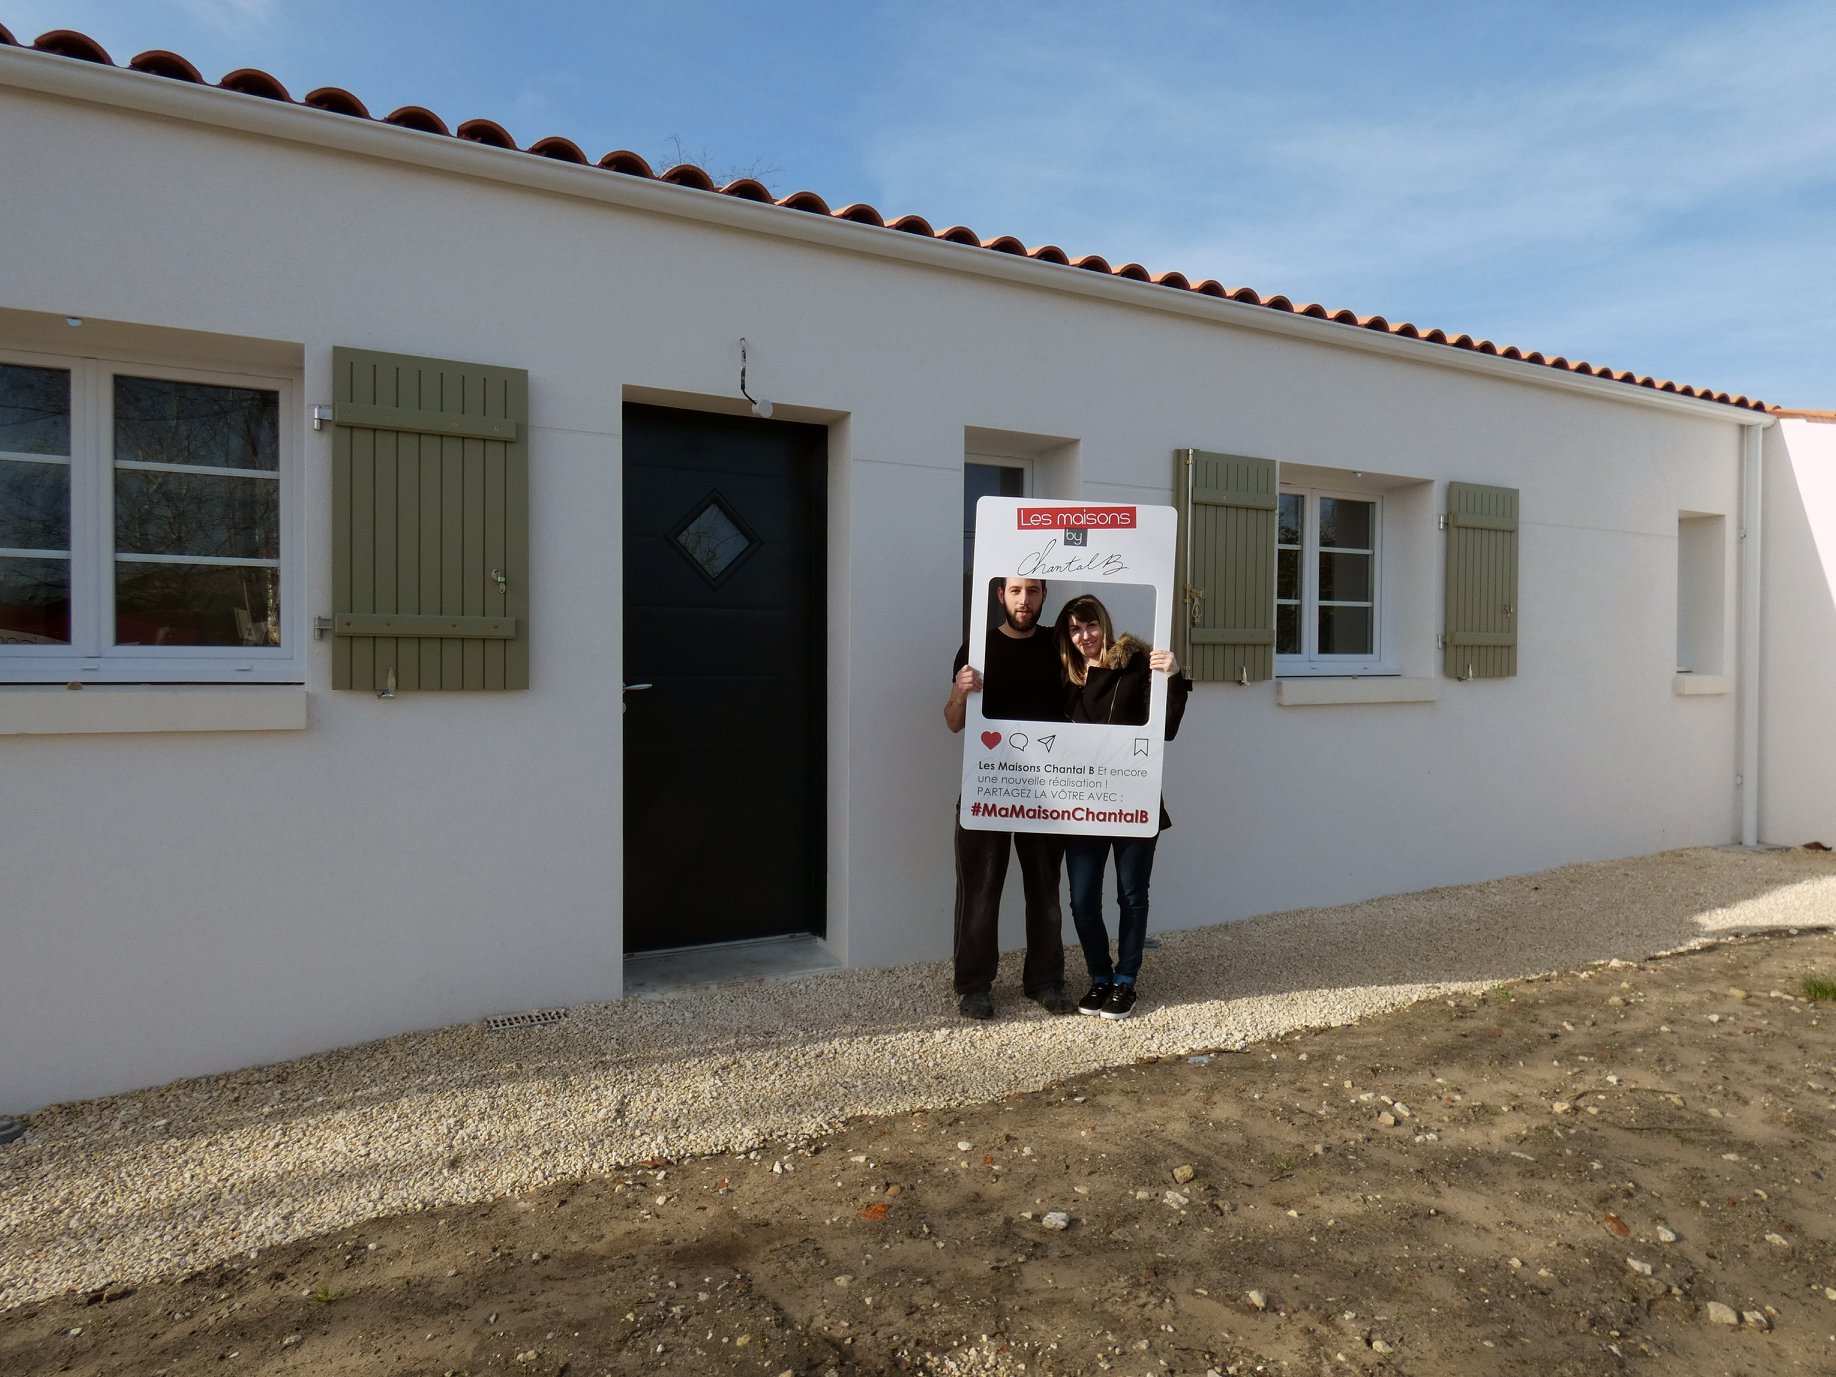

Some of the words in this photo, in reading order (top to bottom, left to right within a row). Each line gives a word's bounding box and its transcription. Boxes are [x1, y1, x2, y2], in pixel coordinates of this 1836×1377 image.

[1021, 509, 1052, 526] Les
[1057, 508, 1131, 526] maisons
[1065, 529, 1084, 545] by
[978, 760, 995, 771] Les
[998, 761, 1041, 773] Maisons
[1044, 764, 1086, 775] Chantal
[1088, 766, 1095, 775] B
[1097, 766, 1109, 776] Et
[1110, 768, 1148, 777] encore
[977, 775, 998, 784] une
[1000, 776, 1046, 786] nouvelle
[1048, 777, 1102, 788] réalisation
[977, 787, 1032, 799] PARTAGEZ
[1034, 789, 1047, 799] LA
[1051, 788, 1085, 801] VÔTRE
[1087, 792, 1118, 802] AVEC
[971, 802, 1150, 825] #MaMaisonChantalB
